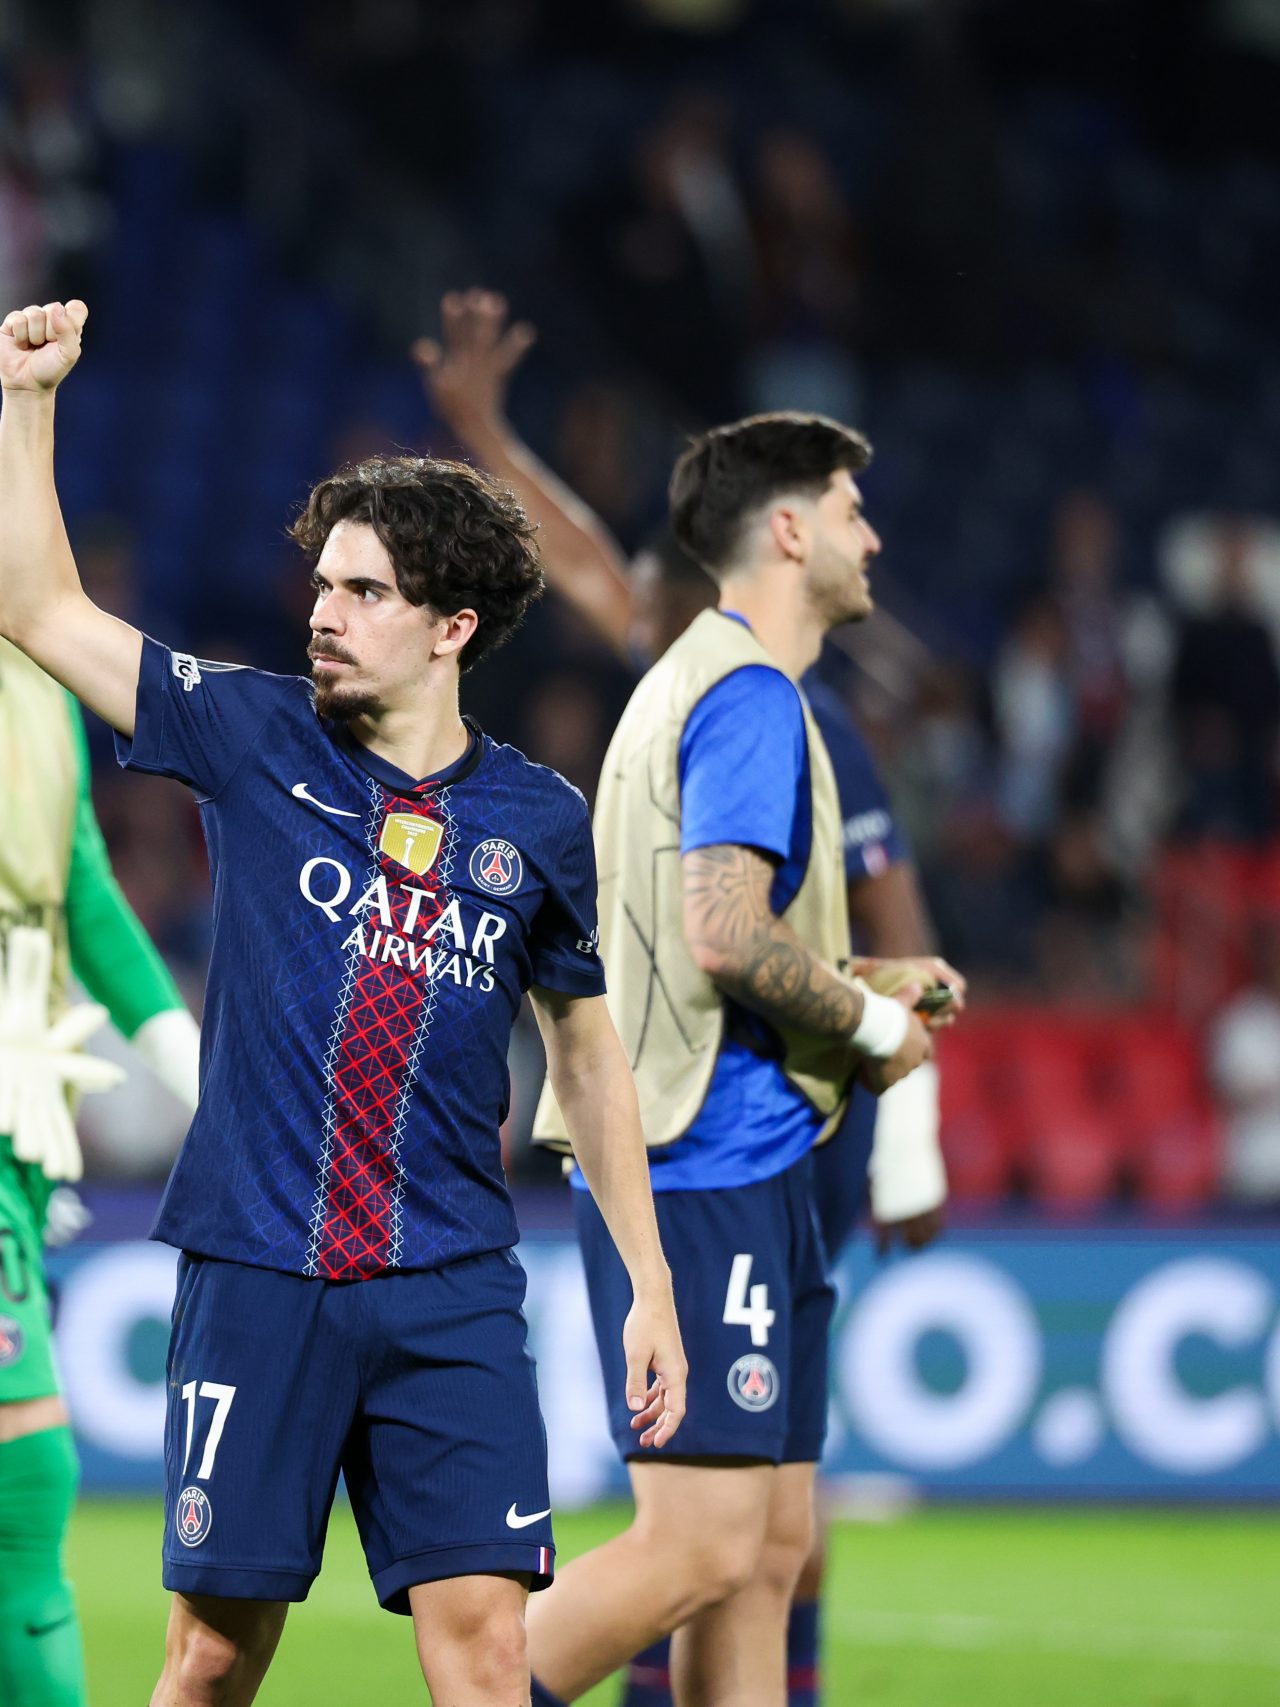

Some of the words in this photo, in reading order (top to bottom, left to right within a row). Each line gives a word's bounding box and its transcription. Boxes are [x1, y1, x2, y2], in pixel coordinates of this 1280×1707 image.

[481, 841, 516, 860] PARIS
[298, 856, 508, 966] QATAR
[339, 923, 497, 993] AIRWAYS
[722, 1253, 776, 1348] 4
[180, 1378, 238, 1480] 17
[181, 1489, 206, 1506] PARIS
